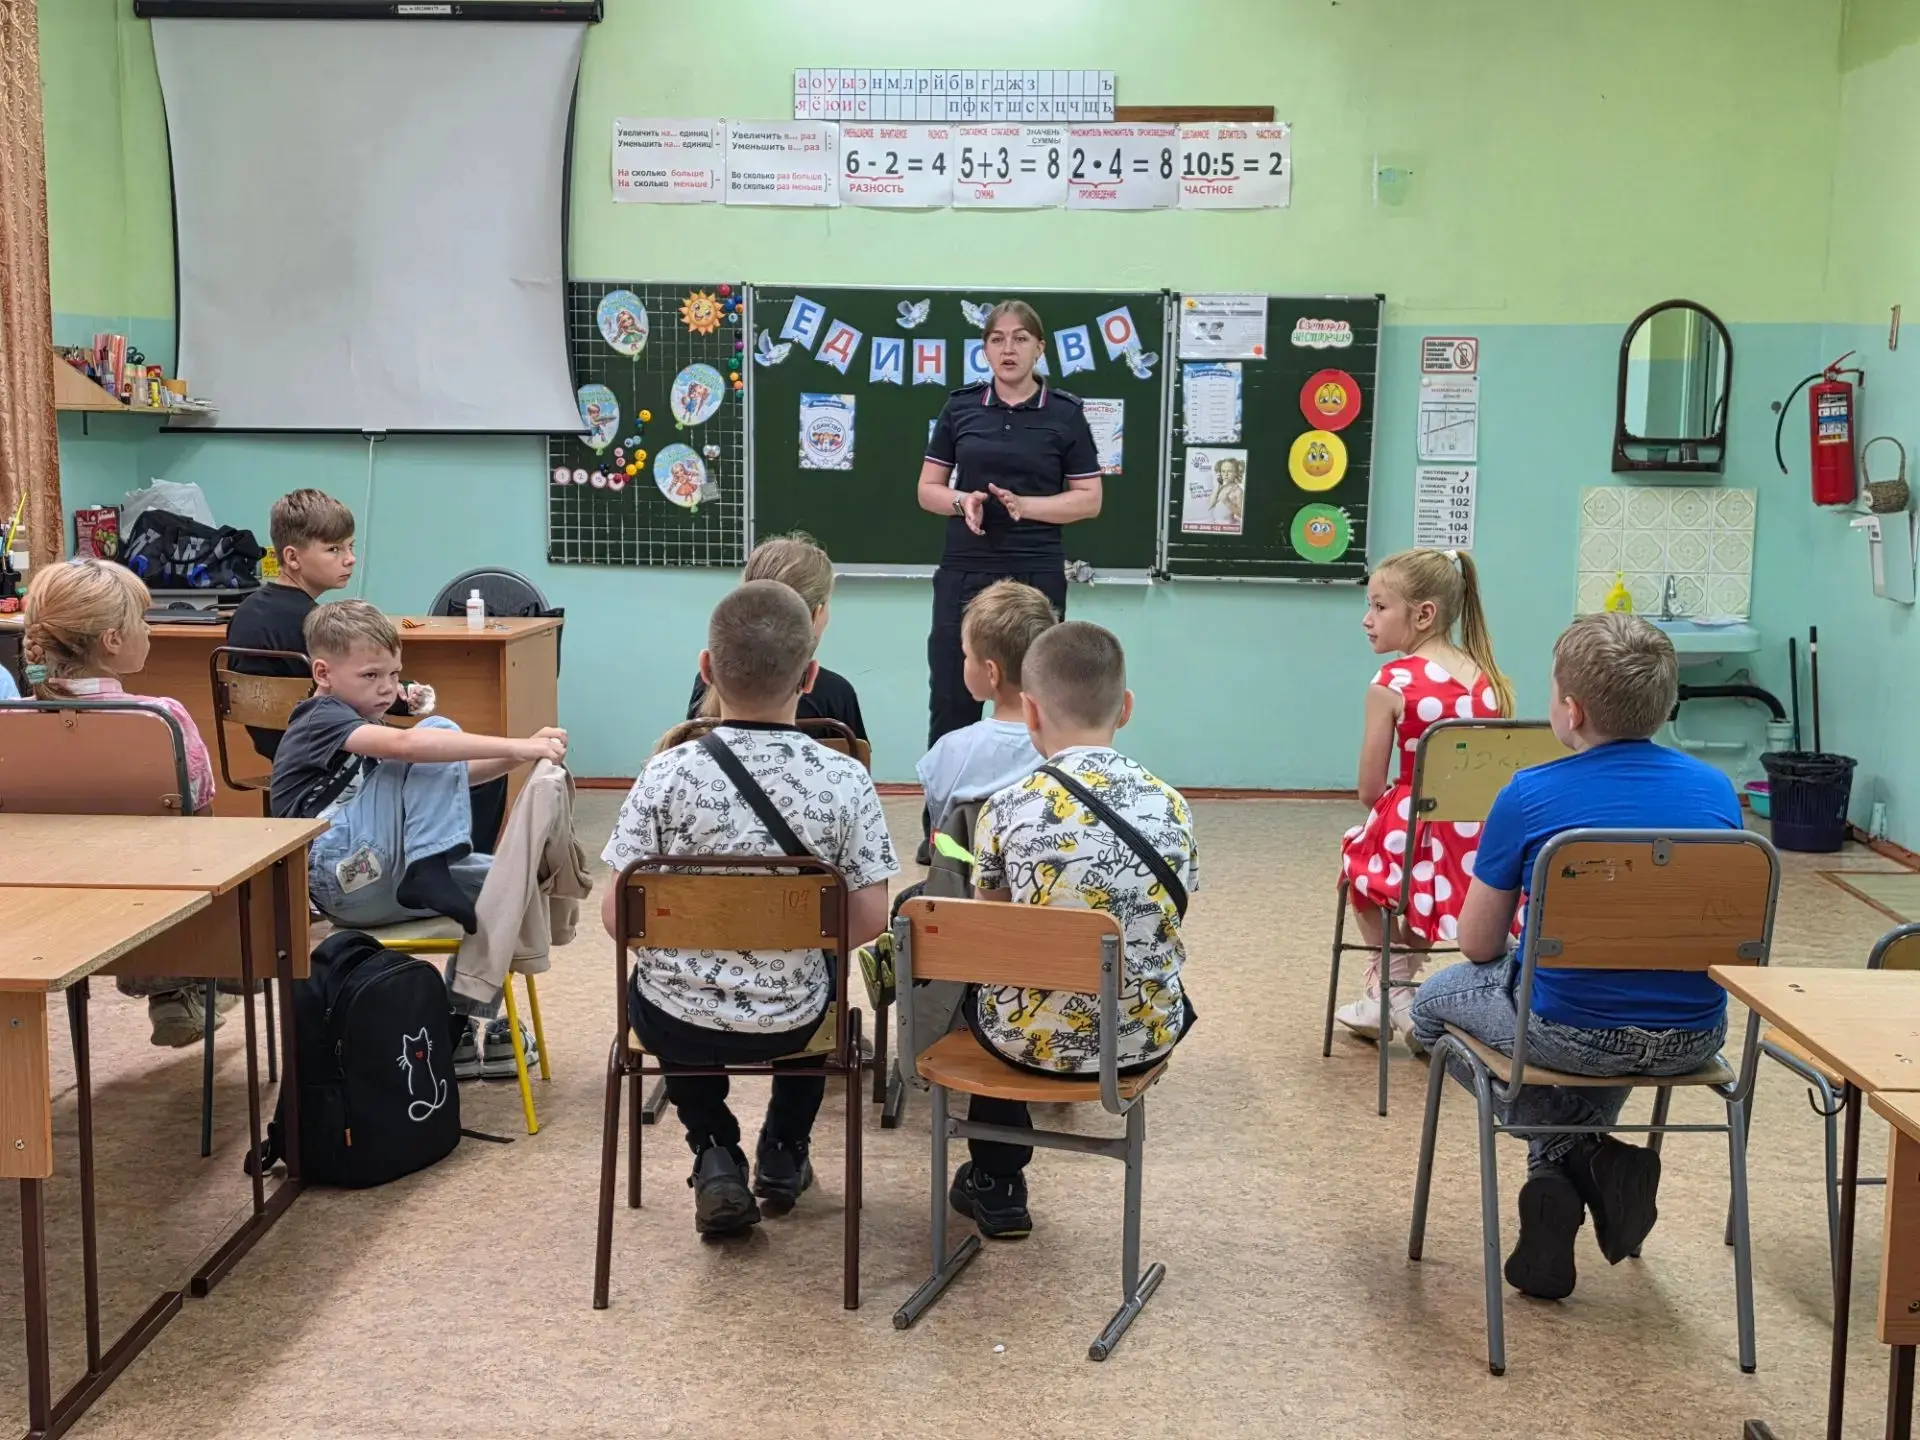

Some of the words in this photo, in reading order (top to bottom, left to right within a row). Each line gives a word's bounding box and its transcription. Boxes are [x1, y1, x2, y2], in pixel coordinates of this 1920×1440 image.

[617, 129, 660, 138] Увеличить
[679, 130, 709, 139] единиц
[731, 131, 782, 141] Увеличить
[800, 132, 816, 142] раз
[1181, 129, 1210, 140] ДЕЛИМОЕ
[1217, 129, 1248, 140] ДЕЛИТЕЛЬ
[1255, 129, 1283, 140] ЧАСТНОЕ
[617, 140, 662, 149] Уменьшить
[682, 140, 711, 149] единиц
[731, 142, 785, 152] Уменьшить
[803, 143, 820, 152] раз
[845, 149, 860, 175] 6
[884, 151, 899, 175] 2
[931, 152, 946, 175] 4
[1047, 147, 1060, 179] 8
[1071, 147, 1085, 179] 2
[1108, 147, 1122, 180] 4
[1159, 147, 1173, 180] 8
[1268, 151, 1283, 176] 2
[617, 169, 630, 177] На
[631, 169, 667, 177] сколько
[670, 168, 704, 178] больше
[731, 171, 742, 180] Во
[743, 172, 775, 180] сколько
[776, 172, 791, 182] раз
[791, 171, 822, 181] больше
[617, 179, 631, 188] На
[633, 180, 669, 188] сколько
[673, 180, 708, 189] меньше
[731, 182, 742, 190] Во
[743, 183, 775, 191] сколько
[776, 183, 791, 192] раз
[791, 183, 823, 192] меньше
[849, 183, 905, 193] РАЗНОСТЬ
[974, 189, 995, 200] СУММА
[1078, 189, 1117, 200] ПРОИЗВЕДЕНИЕ
[1184, 185, 1234, 194] ЧАСТНОЕ
[792, 303, 1131, 374] ЕДИНСВО
[1450, 485, 1470, 494] 101
[1449, 497, 1470, 507] 102
[1448, 510, 1469, 519] 103
[1448, 522, 1468, 531] 104
[1447, 535, 1468, 544] 112
